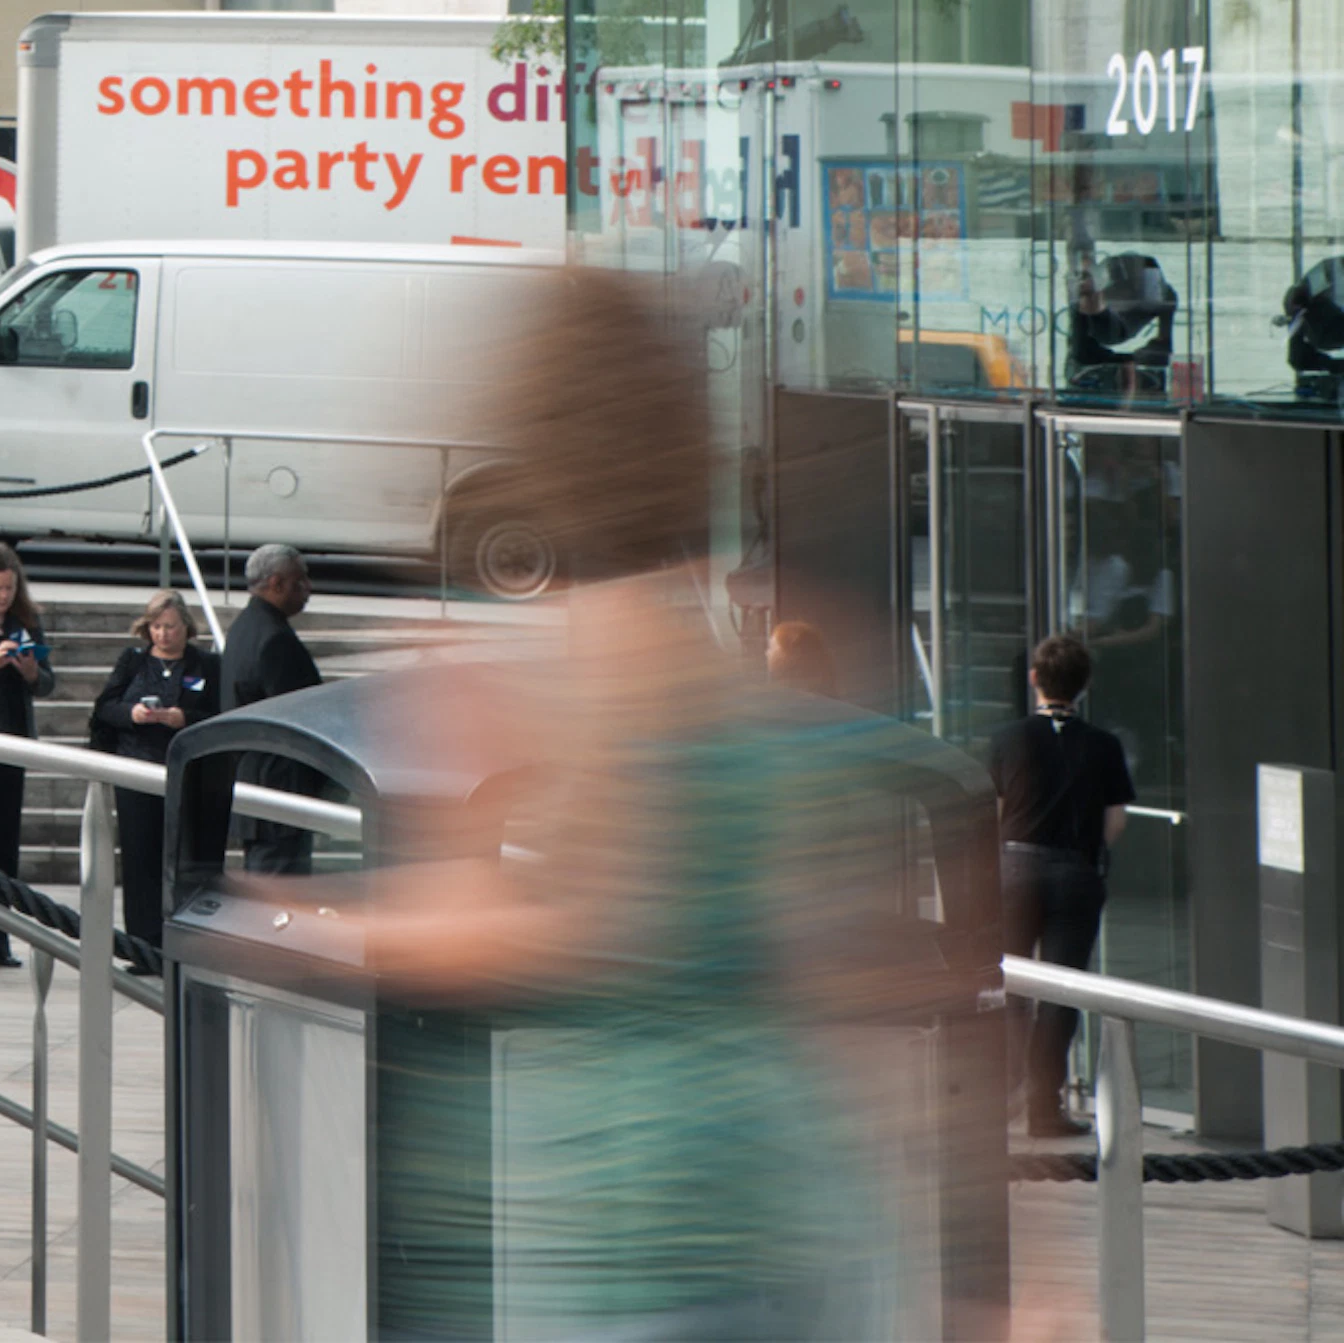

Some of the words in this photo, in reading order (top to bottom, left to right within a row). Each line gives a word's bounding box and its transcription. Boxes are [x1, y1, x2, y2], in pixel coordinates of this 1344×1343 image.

[97, 59, 465, 140] something
[1106, 47, 1205, 136] 2017
[225, 141, 424, 211] party
